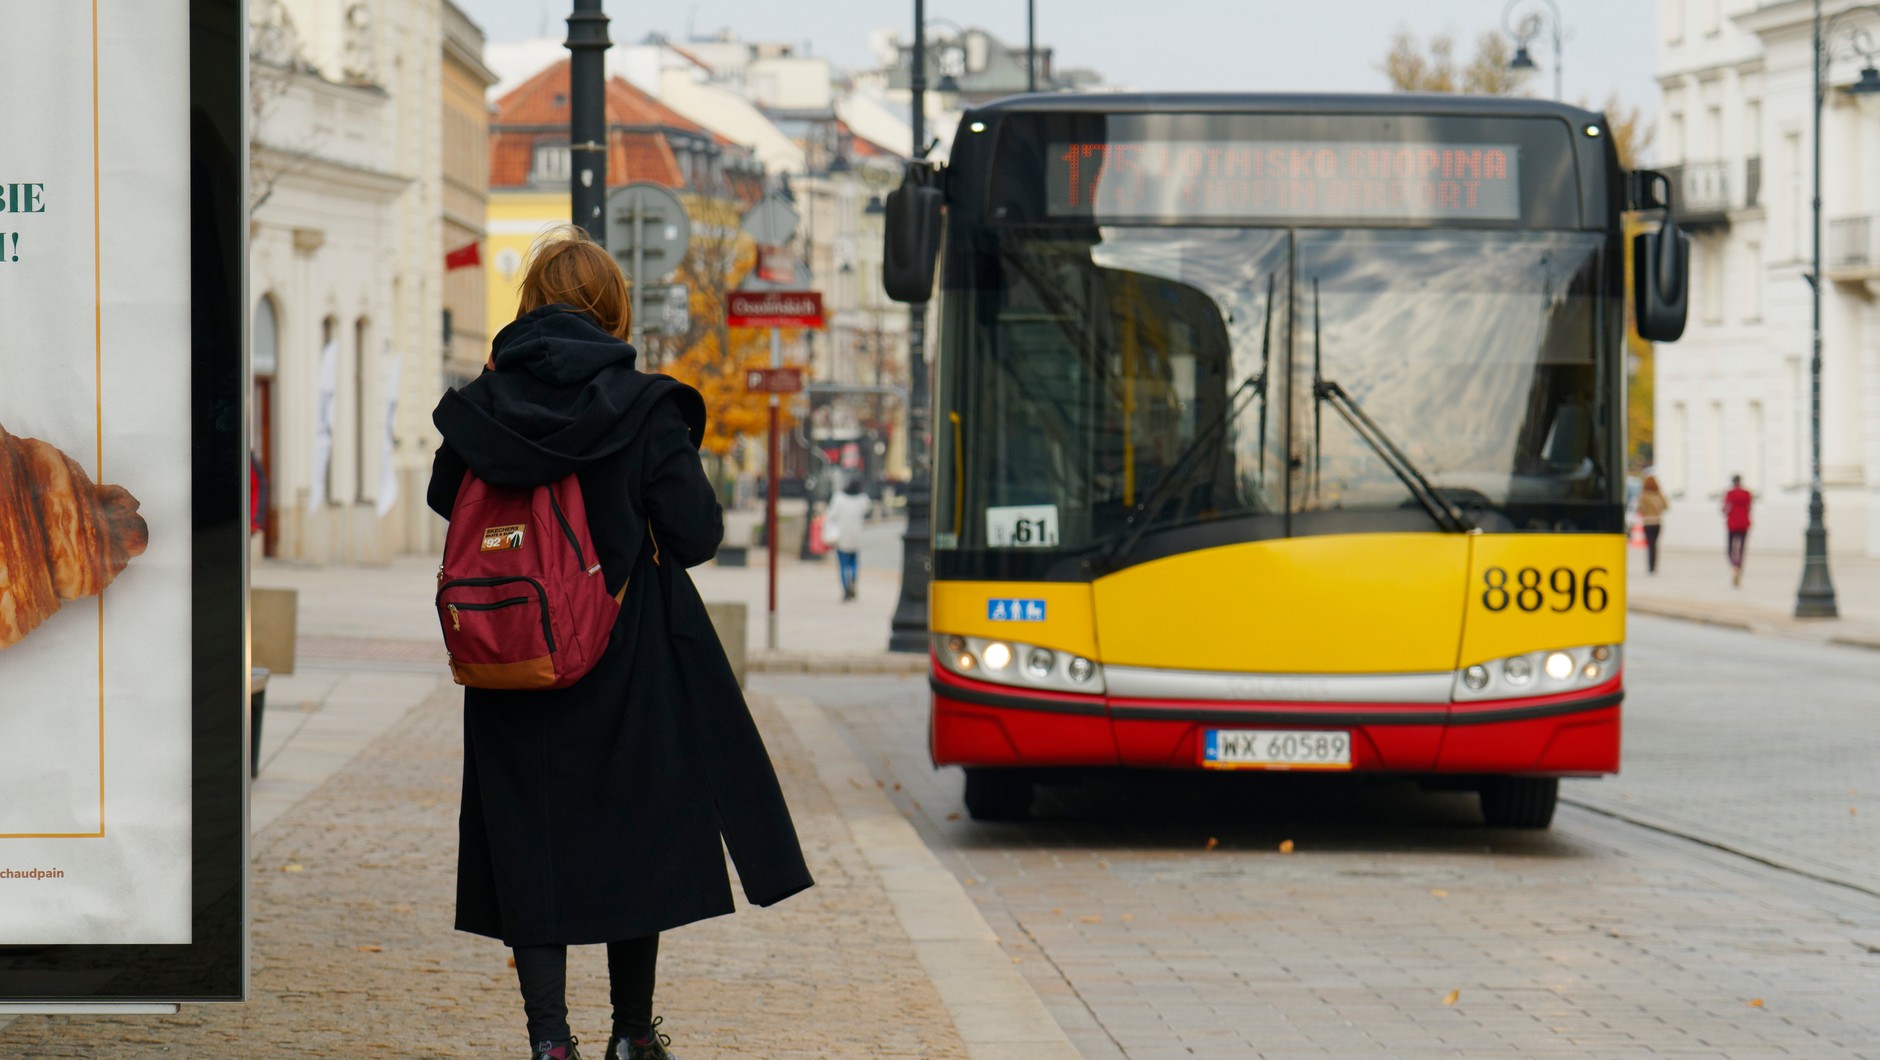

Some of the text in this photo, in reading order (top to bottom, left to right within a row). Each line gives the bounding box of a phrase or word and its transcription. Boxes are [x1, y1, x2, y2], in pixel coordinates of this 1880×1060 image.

[1061, 143, 1145, 207] 175
[1348, 148, 1507, 179] CHOPINA
[0, 183, 46, 213] IE
[486, 526, 519, 534] SKECHERS
[1015, 519, 1046, 543] 61
[1482, 566, 1609, 613] 8896
[1221, 734, 1346, 760] WX 60589
[0, 867, 65, 880] chaudpain
